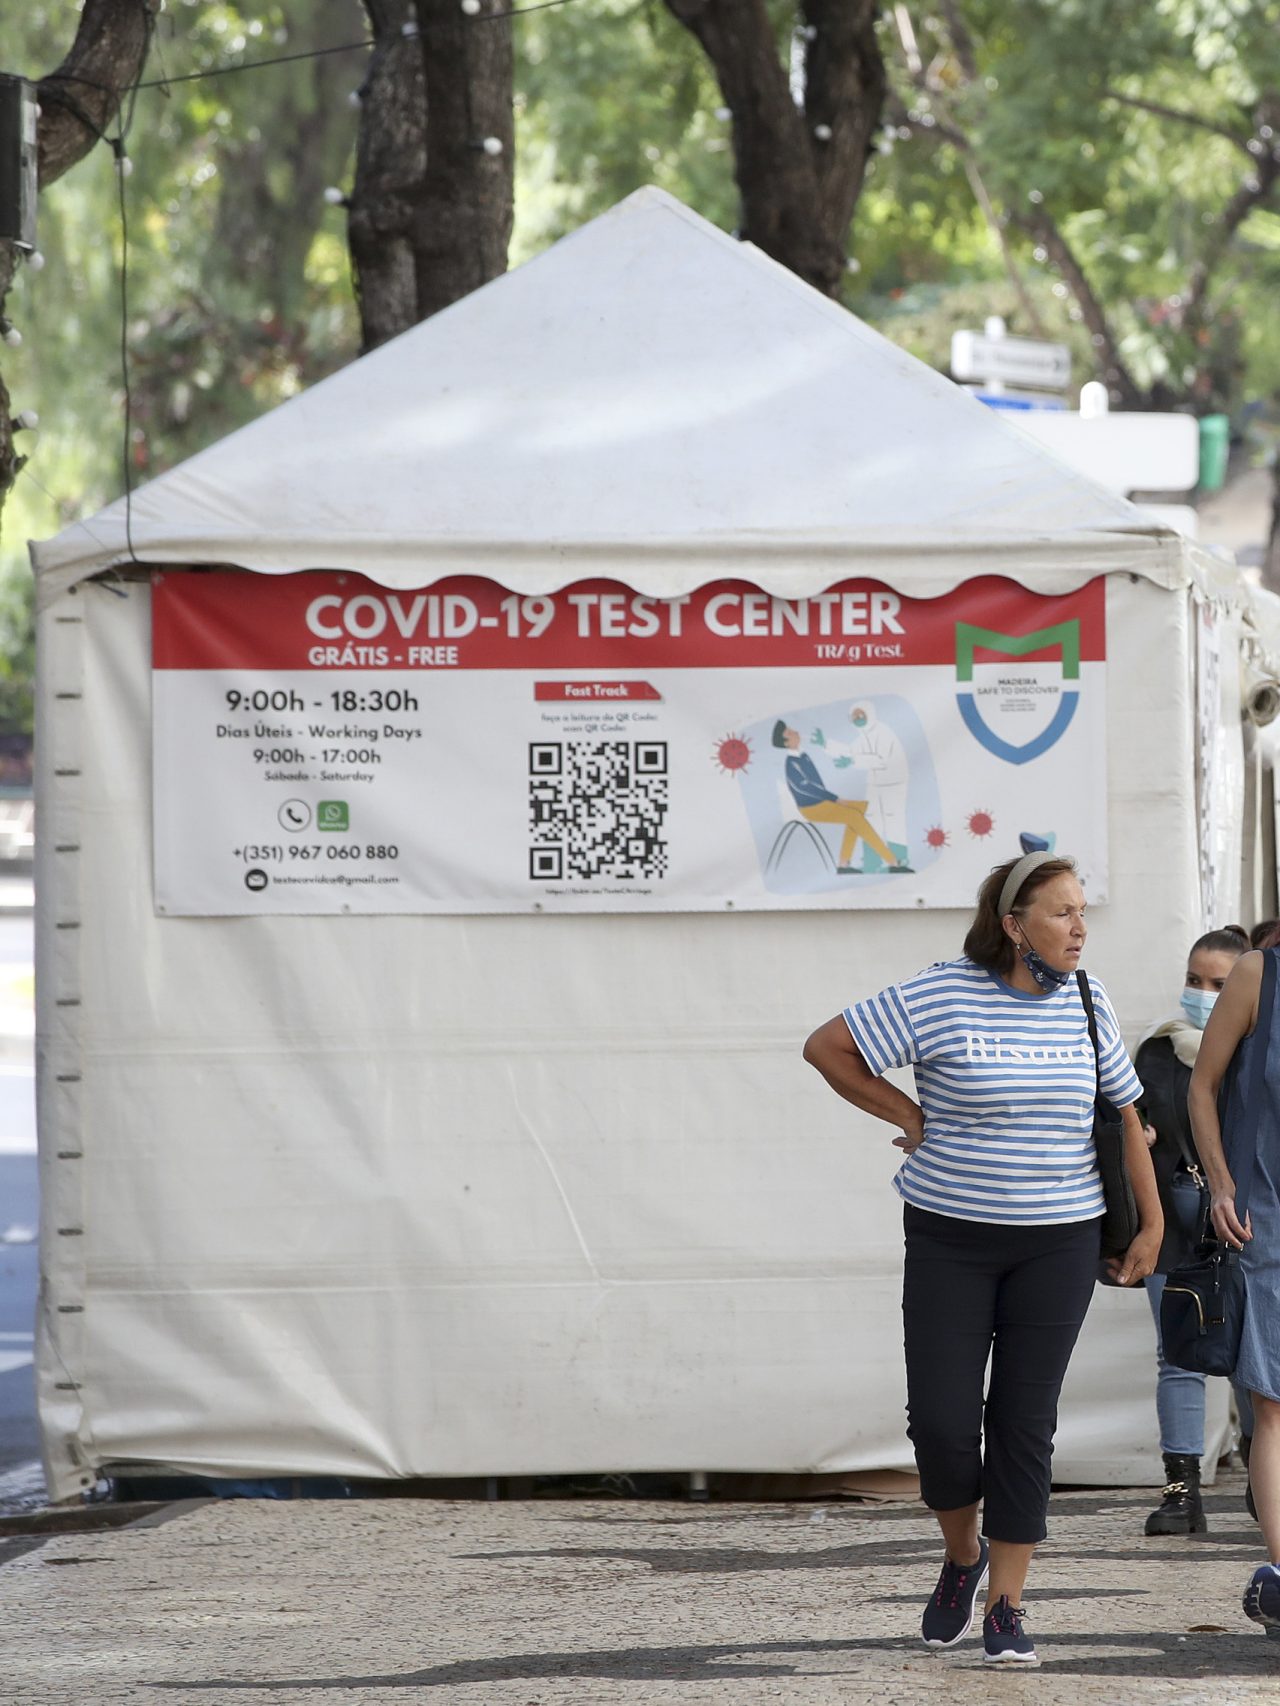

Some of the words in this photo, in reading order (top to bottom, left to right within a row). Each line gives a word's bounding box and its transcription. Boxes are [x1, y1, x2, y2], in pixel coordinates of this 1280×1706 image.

[305, 594, 555, 639] COVID-19
[567, 594, 691, 638] TEST
[703, 593, 906, 637] CENTER
[308, 641, 389, 666] GRÁTIS
[408, 646, 459, 666] FREE
[863, 643, 905, 659] Test
[564, 684, 592, 697] Fast
[593, 683, 629, 697] Track
[226, 689, 305, 712] 9:00h
[330, 689, 419, 712] 18:30h
[216, 724, 250, 738] Dias
[254, 719, 293, 738] Úteis
[308, 724, 379, 742] Working
[383, 725, 423, 742] Days
[253, 748, 305, 764] 9:00h
[321, 748, 381, 764] 17:00h
[319, 769, 375, 783] Saturday
[232, 845, 284, 864] +(351)
[288, 845, 322, 860] 967
[326, 845, 361, 860] 060
[365, 845, 399, 860] 880
